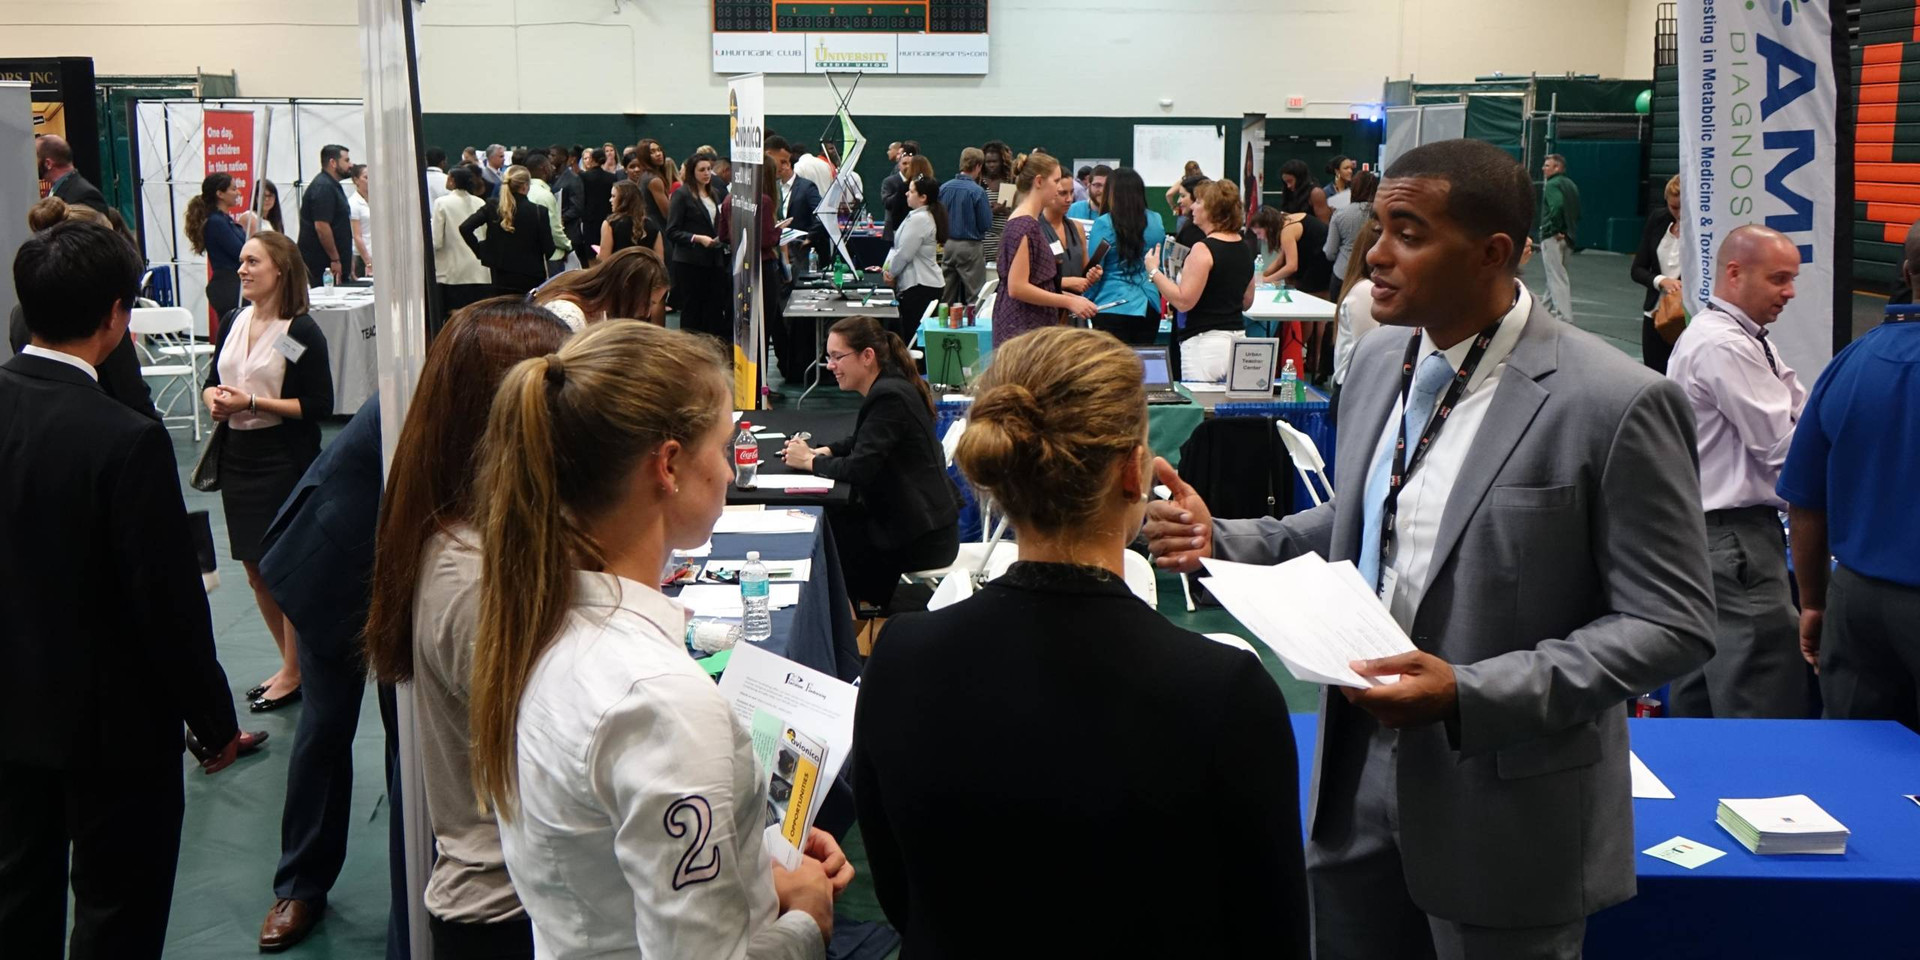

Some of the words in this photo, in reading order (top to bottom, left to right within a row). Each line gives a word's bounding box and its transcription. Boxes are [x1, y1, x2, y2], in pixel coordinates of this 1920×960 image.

[815, 47, 888, 62] UNIVERSITY
[1702, 49, 1717, 63] in
[30, 71, 58, 84] INC.
[1700, 68, 1716, 142] Metabolic
[207, 127, 220, 138] One
[221, 127, 234, 140] day,
[1729, 32, 1753, 225] DIAGNOS
[207, 144, 216, 156] all
[216, 143, 240, 155] children
[208, 161, 215, 173] in
[215, 160, 228, 173] this
[228, 160, 248, 172] nation
[1700, 146, 1715, 212] Medicine
[1700, 216, 1713, 227] &
[1698, 232, 1713, 305] Toxicology
[790, 738, 820, 762] avionica
[790, 772, 809, 837] OPPORTUNITIES
[663, 795, 721, 891] 2
